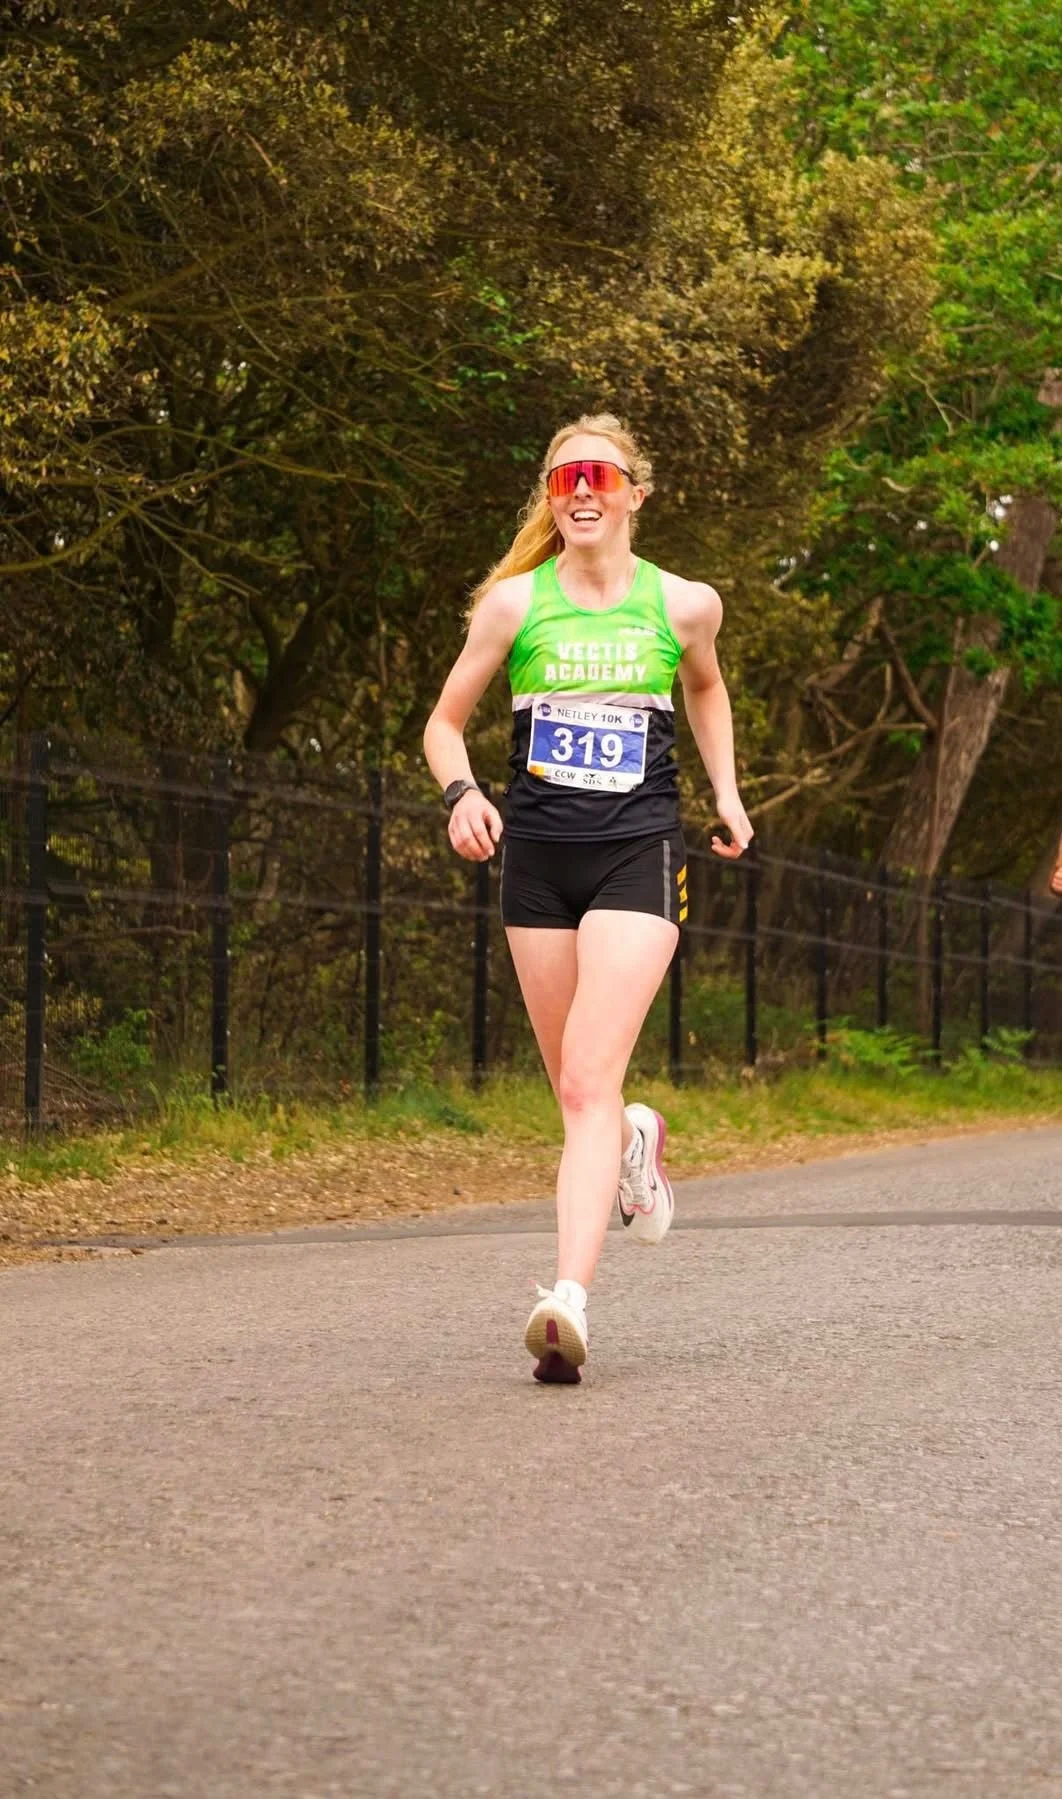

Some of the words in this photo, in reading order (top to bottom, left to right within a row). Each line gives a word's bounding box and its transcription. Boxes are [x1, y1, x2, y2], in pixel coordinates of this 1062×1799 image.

[556, 641, 638, 660] VECTIS
[544, 663, 647, 682] ACADEMY
[557, 708, 598, 721] NETLEY
[600, 713, 623, 724] 10K
[551, 727, 623, 768] 319
[554, 769, 576, 780] CCW
